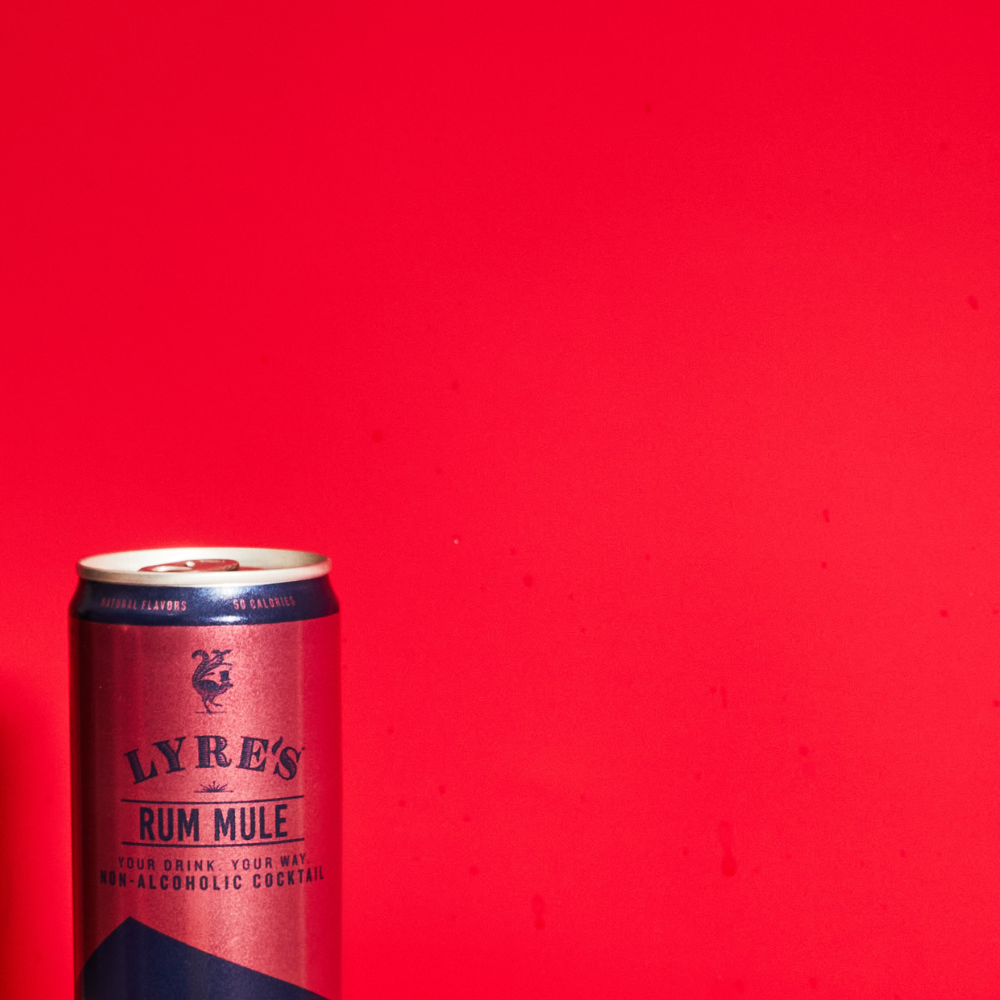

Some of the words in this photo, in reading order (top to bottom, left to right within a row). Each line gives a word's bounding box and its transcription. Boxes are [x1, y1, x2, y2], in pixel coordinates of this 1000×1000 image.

[101, 597, 137, 610] NATURAL
[141, 600, 187, 612] FLAVORS
[233, 598, 246, 610] 50
[250, 596, 296, 610] CALORIES
[124, 735, 303, 785] LYRE'S
[139, 806, 200, 842] RUM
[214, 804, 288, 841] MULE
[118, 856, 156, 871] YOUR
[164, 859, 222, 872] DRINK.
[231, 857, 273, 871] YOUR
[100, 869, 243, 891] NON-ALCOHOLIC
[252, 866, 325, 890] COCKTAIL
